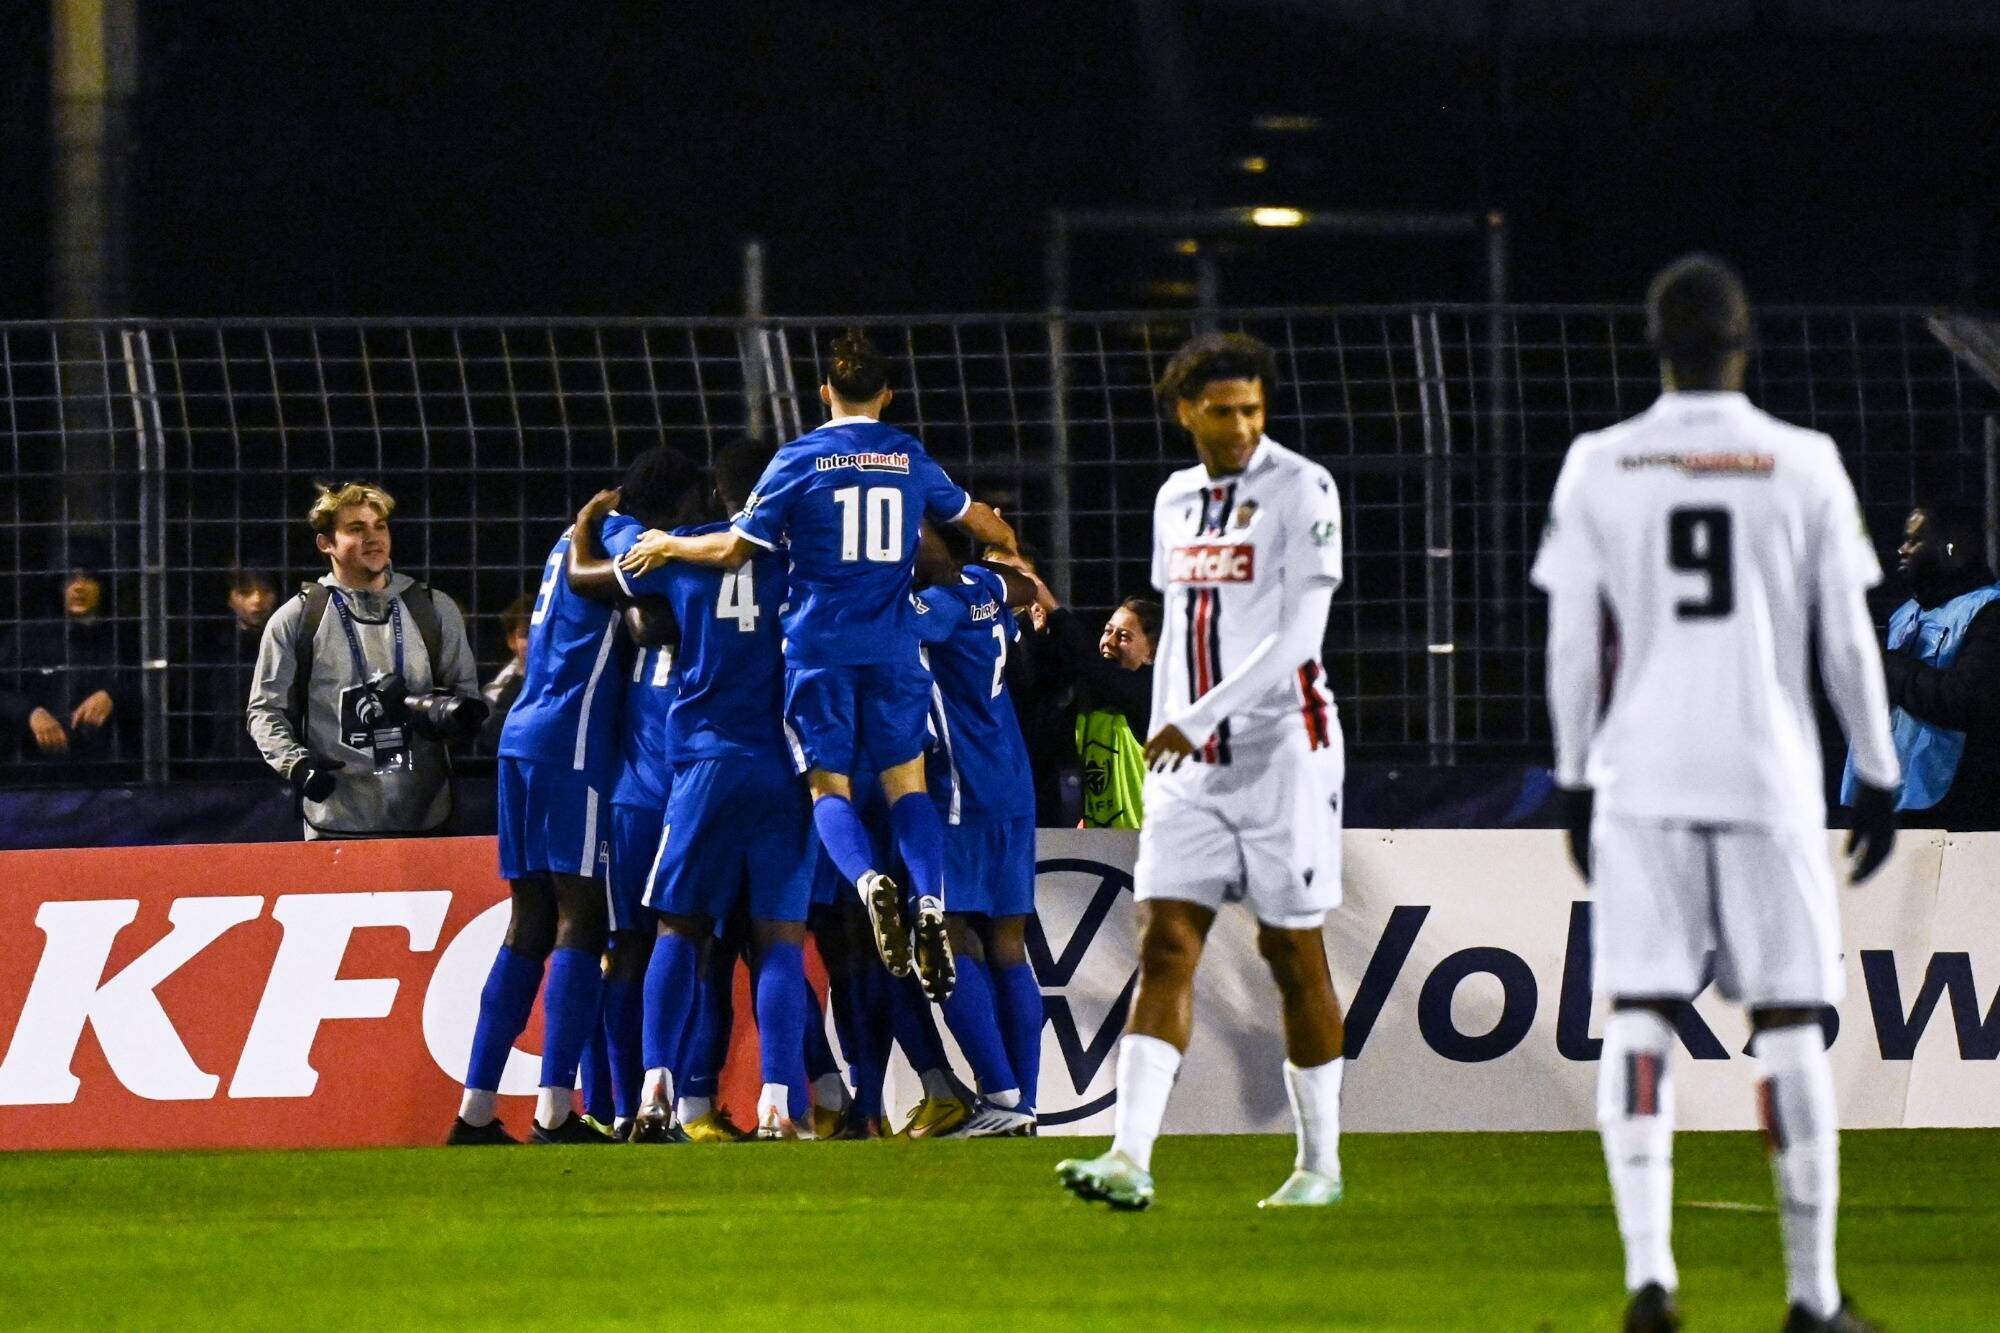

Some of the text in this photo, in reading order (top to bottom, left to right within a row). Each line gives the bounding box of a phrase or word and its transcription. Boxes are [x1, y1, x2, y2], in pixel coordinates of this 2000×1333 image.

[834, 486, 903, 561] 10
[531, 552, 563, 626] 3
[716, 559, 760, 632] 4
[1666, 505, 1736, 619] 9
[991, 624, 1006, 699] 2
[0, 890, 582, 1105] KFC
[1343, 899, 2000, 1063] Volw
